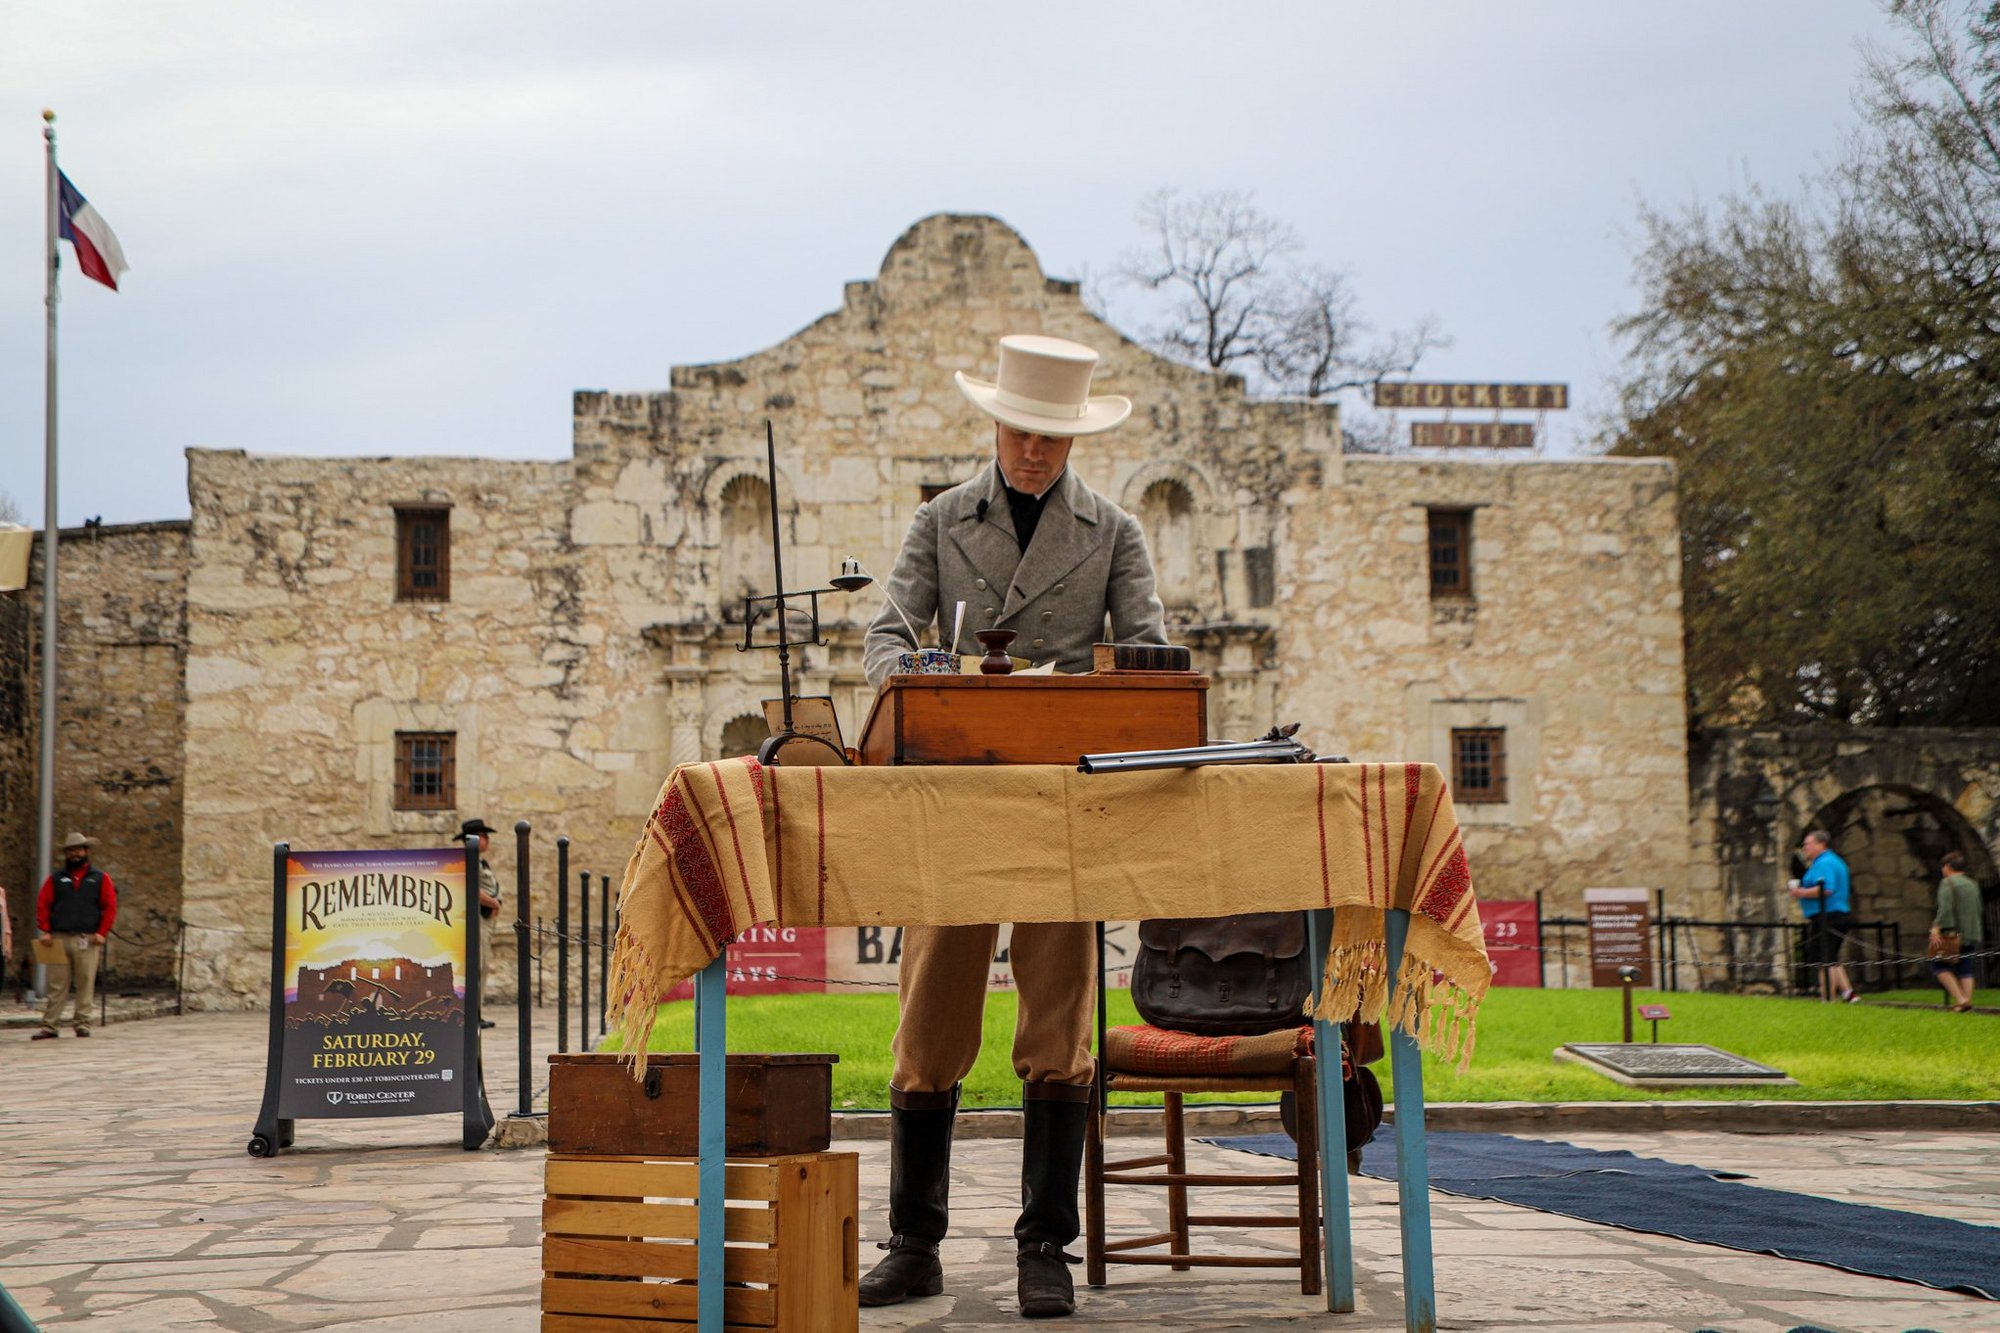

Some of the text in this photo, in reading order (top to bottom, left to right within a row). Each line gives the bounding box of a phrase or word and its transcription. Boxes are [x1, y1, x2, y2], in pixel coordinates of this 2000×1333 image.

[1378, 384, 1566, 407] CROCKETT
[301, 873, 453, 932] REMEMBER
[1495, 922, 1518, 938] 23
[726, 966, 778, 982] AYS
[322, 1033, 426, 1050] SATURDAY,
[312, 1049, 436, 1069] FEBRUARY 29
[374, 1073, 440, 1082] TOBINCENTER.ORG
[344, 1090, 416, 1100] TOBIN CENTER
